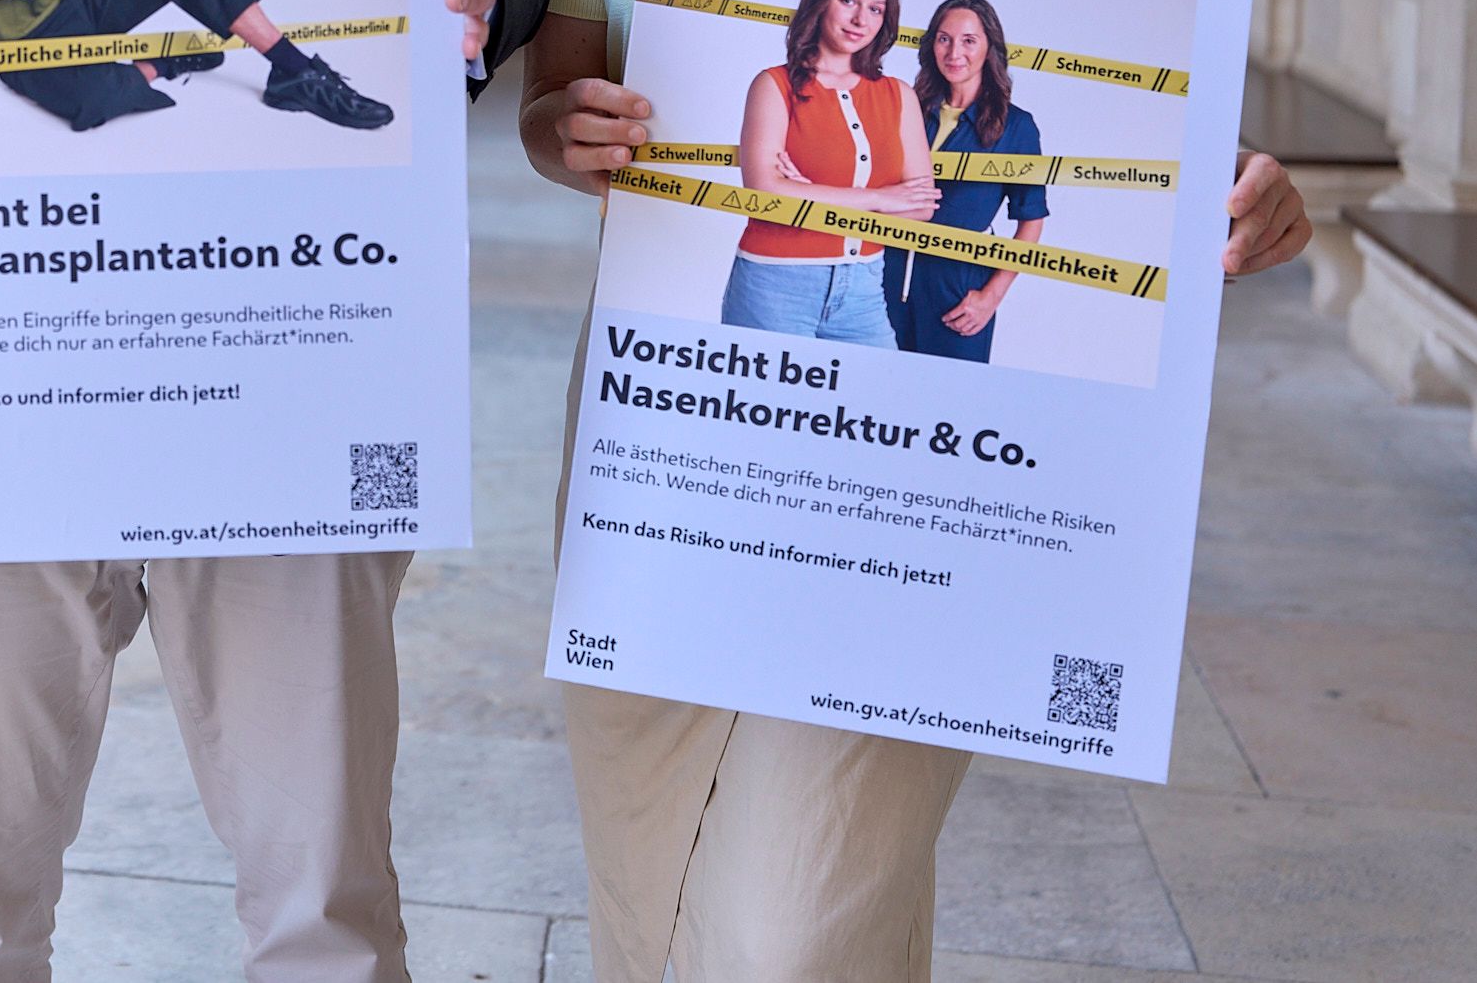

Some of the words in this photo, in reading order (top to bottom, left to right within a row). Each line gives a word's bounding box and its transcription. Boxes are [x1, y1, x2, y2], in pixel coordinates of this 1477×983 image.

[734, 4, 790, 23] Schmerzen
[284, 23, 339, 39] natürliche
[343, 21, 391, 36] Haarlinie
[68, 39, 148, 59] Haarlinie
[1056, 57, 1141, 83] Schmerzen
[650, 146, 733, 166] Schwellung
[611, 170, 683, 196] dlichkeit
[1074, 166, 1170, 187] Schwellung
[40, 192, 100, 226] bei
[291, 234, 321, 267] &
[333, 233, 398, 265] Co.
[824, 210, 1118, 283] Berührungsempfindlichkeit
[24, 310, 100, 332] Eingriffe
[105, 310, 176, 330] bringen
[181, 304, 324, 329] gesundheitliche
[329, 303, 392, 320] Risiken
[14, 335, 51, 352] dich
[57, 339, 87, 351] nur
[92, 338, 114, 350] an
[119, 332, 207, 349] erfahrene
[608, 325, 769, 380] Vorsicht
[779, 351, 840, 391] bei
[18, 388, 52, 405] und
[58, 387, 144, 404] informier
[150, 385, 188, 402] dich
[193, 384, 240, 405] jetzt!
[600, 371, 920, 449] Nasenkorrektur
[929, 422, 961, 457] &
[973, 429, 1036, 468] Co.
[590, 463, 618, 479] mit
[623, 467, 660, 486] sich.
[667, 473, 729, 497] Wende
[734, 484, 771, 504] dich
[776, 495, 806, 509] nur
[810, 500, 832, 514] an
[837, 503, 925, 529] erfahrene
[592, 438, 625, 457] Alle
[630, 444, 741, 476] ästhetischen
[747, 462, 822, 489] Eingriffe
[827, 474, 897, 502] bringen
[902, 492, 1047, 524] gesundheitliche
[1052, 510, 1115, 535] Risiken
[121, 517, 418, 545] wien.gv.at/schoenheitseingriffe
[583, 512, 629, 534] Kenn
[634, 521, 665, 540] das
[671, 527, 724, 549] Risiko
[730, 538, 765, 556] und
[769, 543, 856, 570] informier
[860, 558, 898, 578] dich
[903, 565, 951, 586] jetzt!
[568, 629, 616, 652] Stadt
[566, 648, 613, 671] Wien
[811, 693, 1113, 756] wien.gv.at/schoenheitseingriffe
